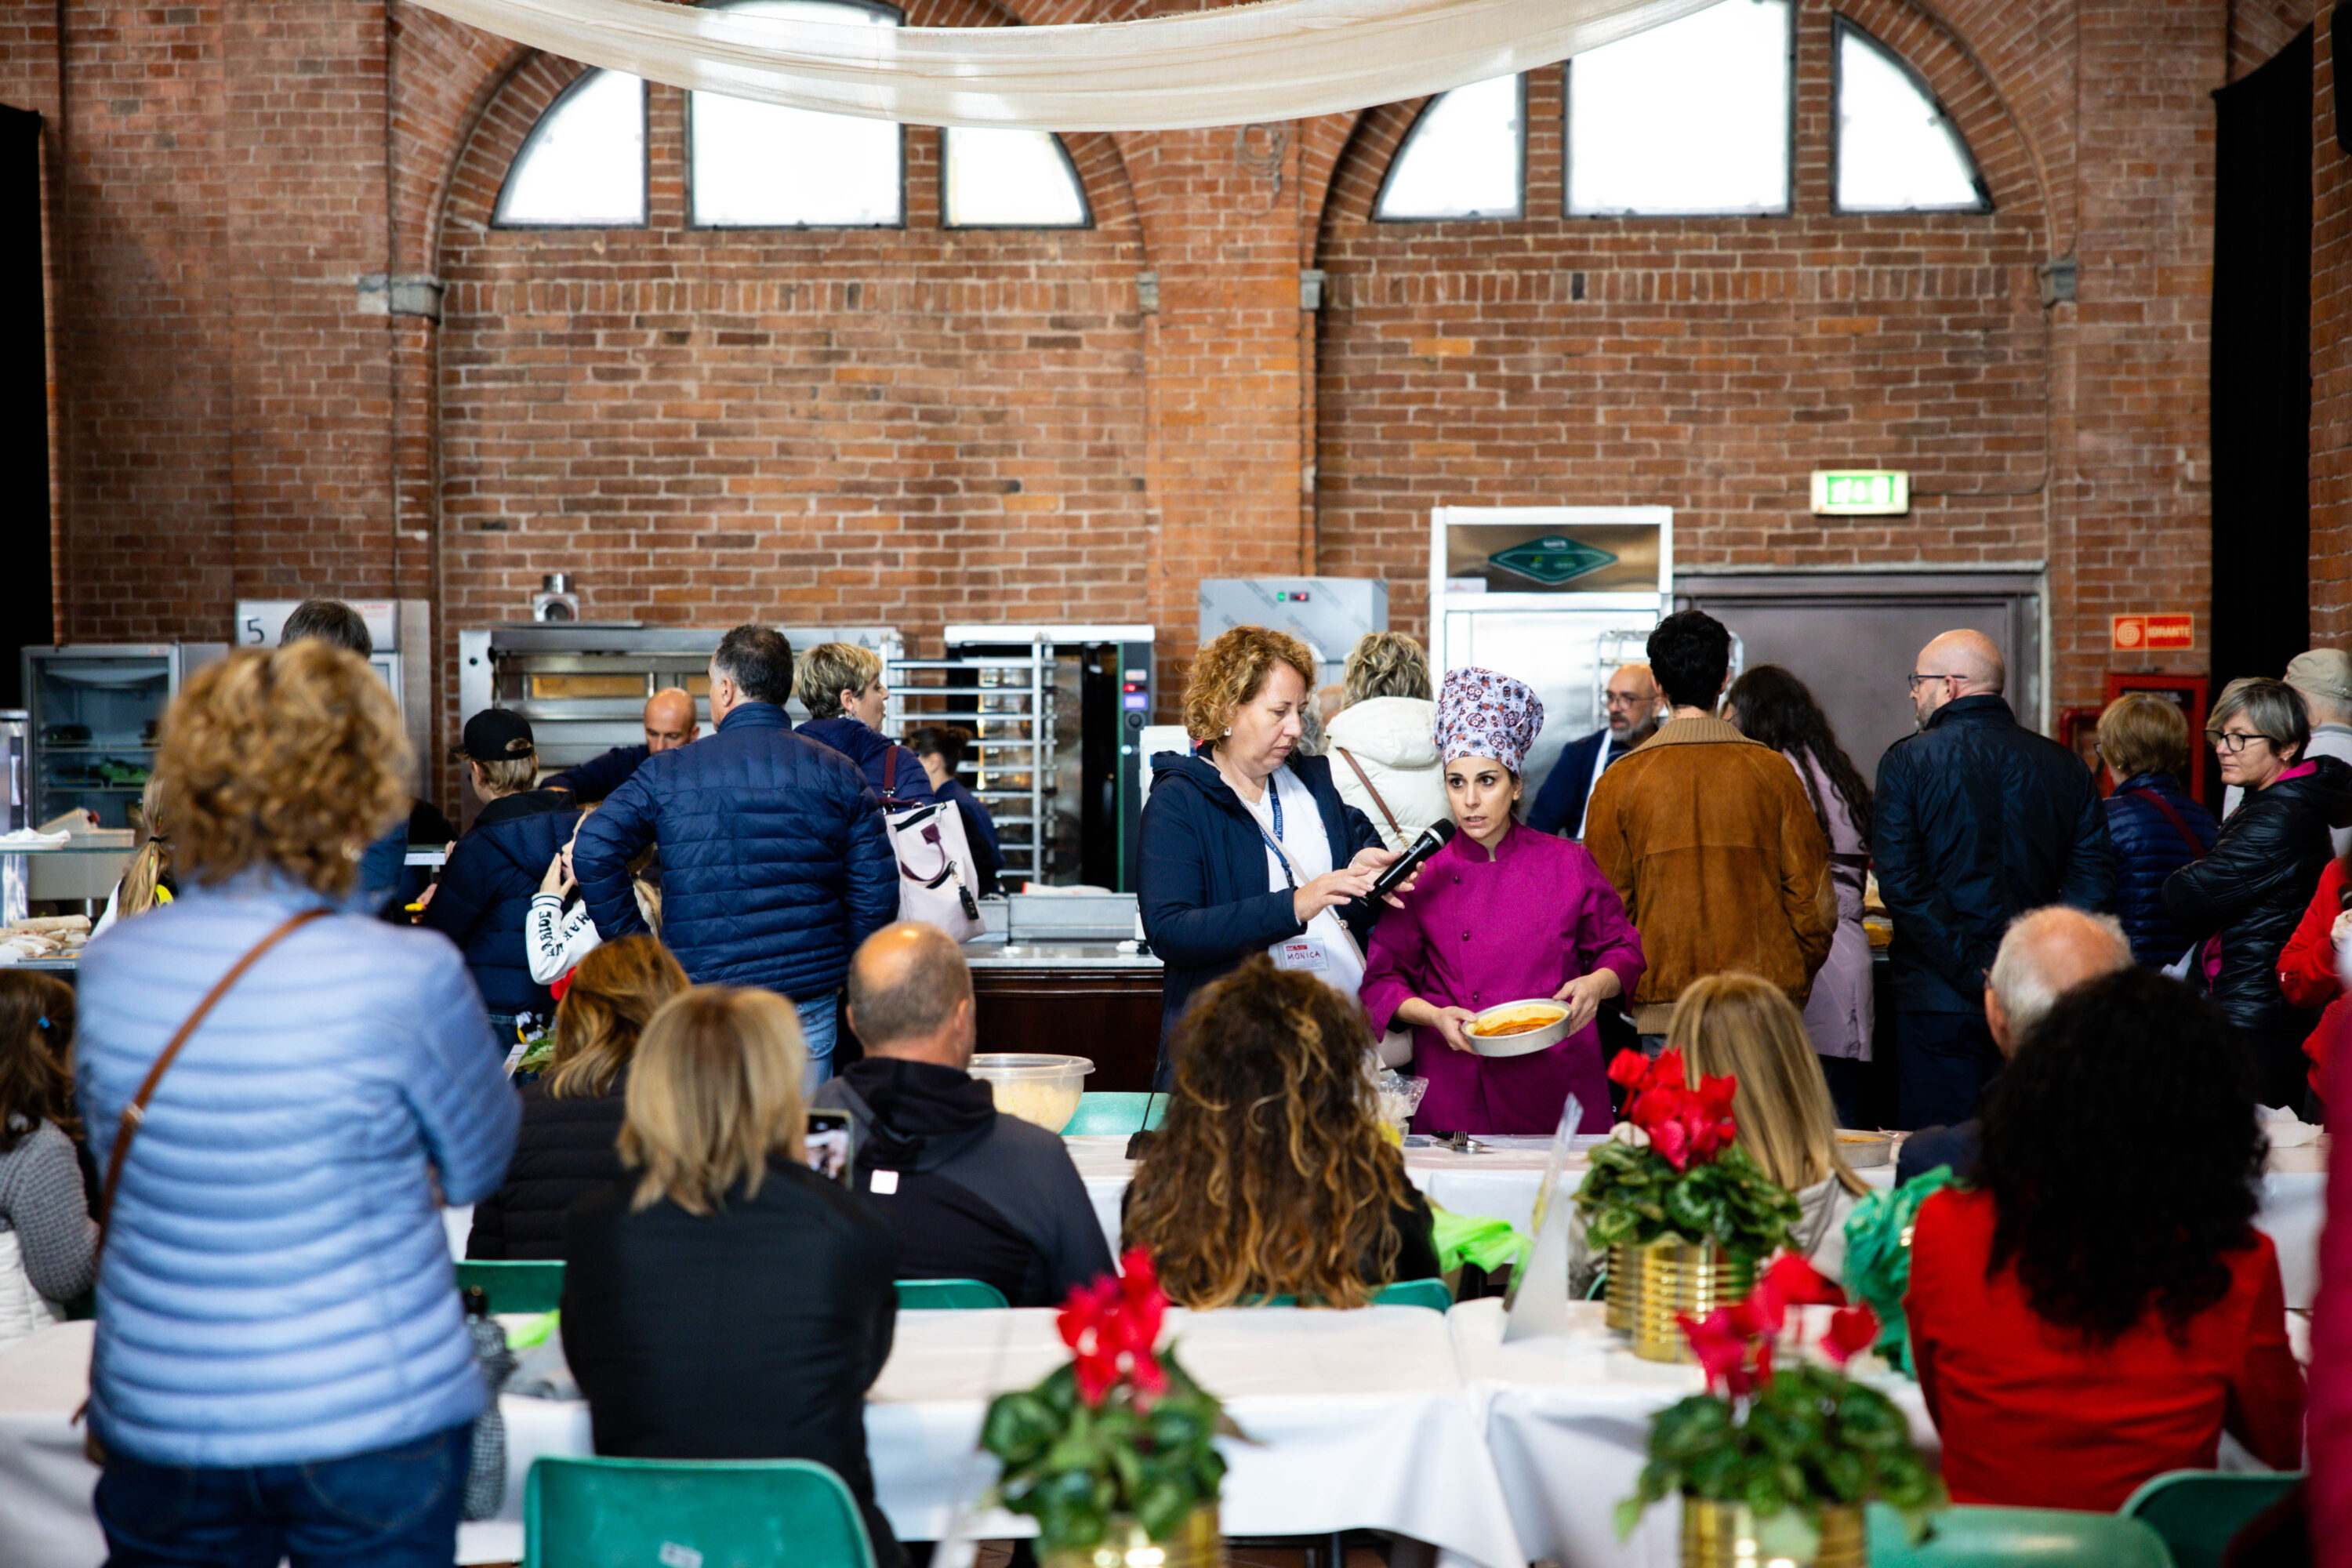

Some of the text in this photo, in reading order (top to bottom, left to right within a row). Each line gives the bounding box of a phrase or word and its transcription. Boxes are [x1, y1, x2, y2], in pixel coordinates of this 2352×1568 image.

[246, 617, 265, 644] 5
[2148, 625, 2191, 638] IDRANTE
[1287, 950, 1322, 960] MONICA
